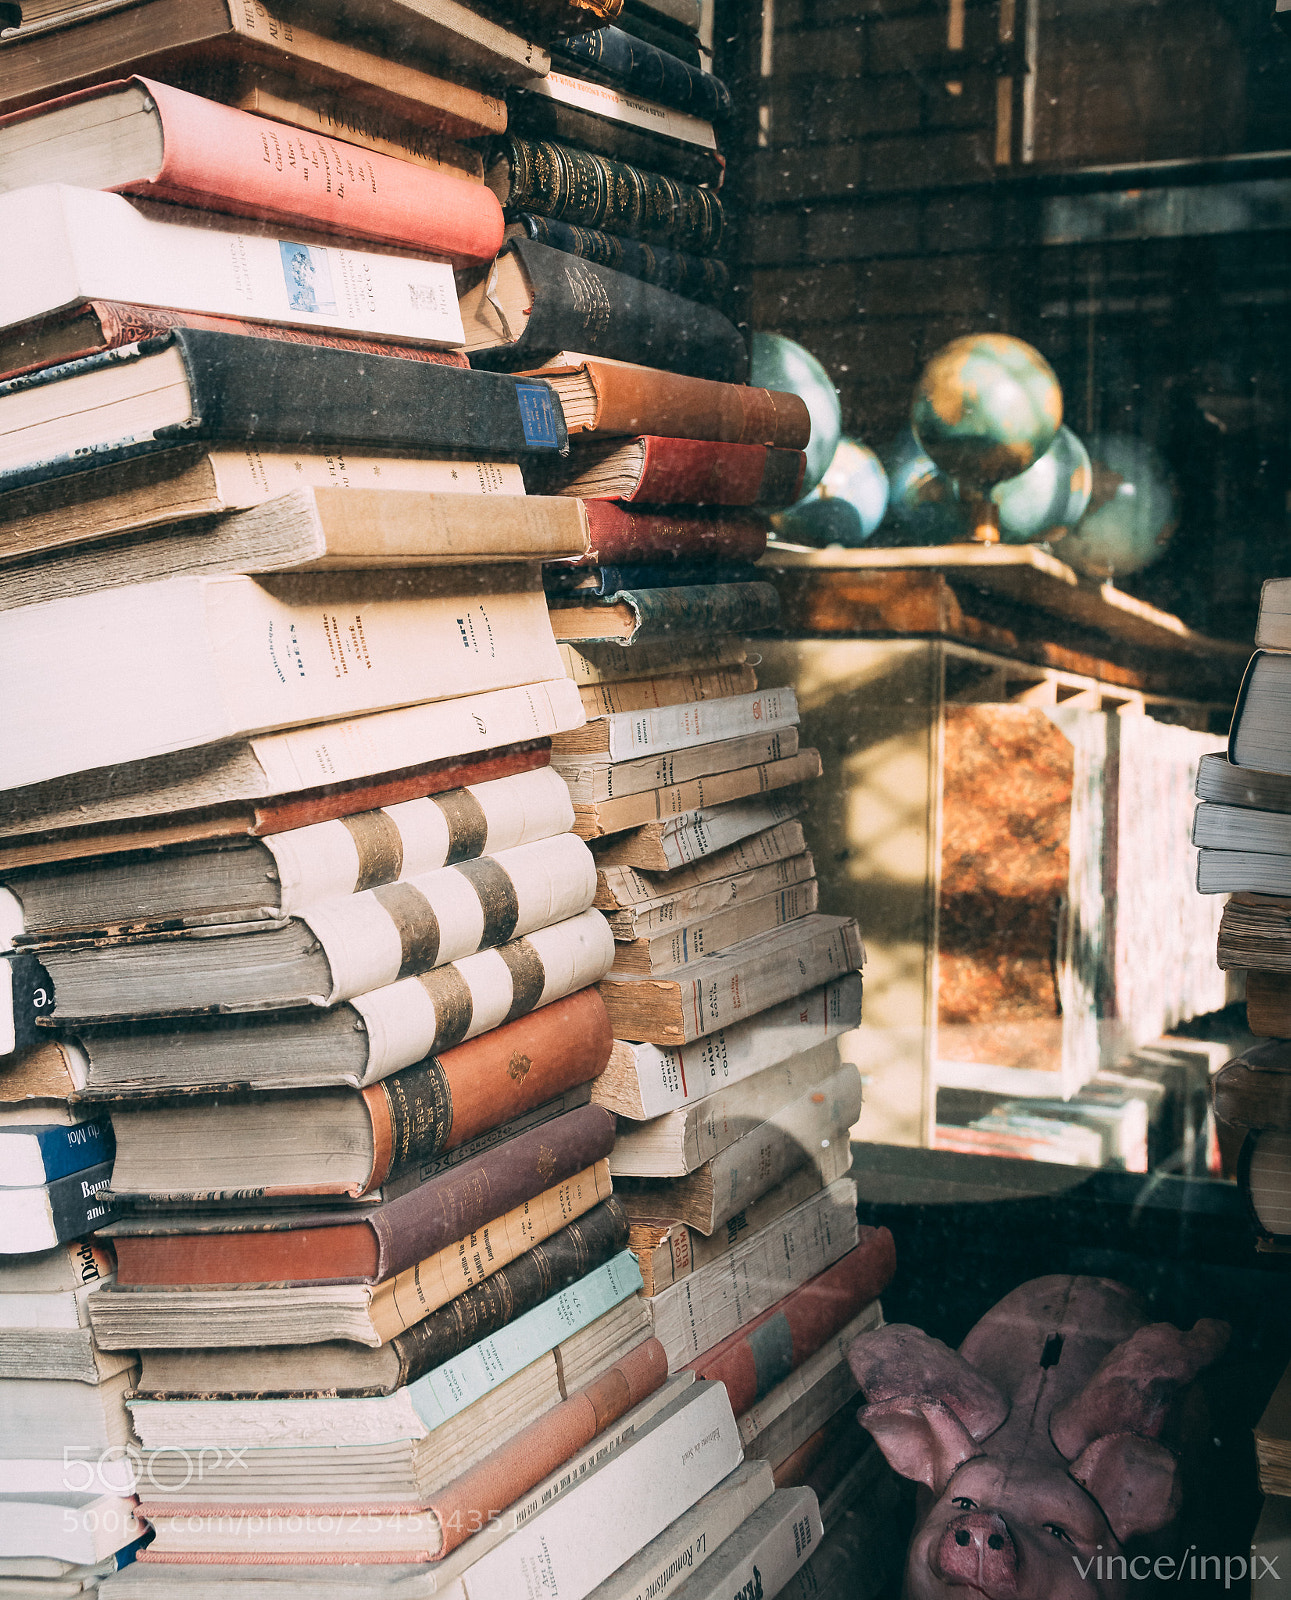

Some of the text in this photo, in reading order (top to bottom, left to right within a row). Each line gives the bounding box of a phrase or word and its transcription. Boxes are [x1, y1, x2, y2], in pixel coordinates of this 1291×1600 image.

[244, 6, 254, 28] THE
[268, 130, 285, 172] Carroll
[283, 139, 298, 169] Alice
[301, 166, 311, 182] au
[356, 165, 366, 181] du
[333, 180, 347, 199] De
[701, 1051, 706, 1062] LE
[714, 1045, 720, 1058] AU
[426, 1064, 443, 1121] TEMPS
[392, 1079, 413, 1161] DANIEL-ROPS
[67, 1130, 88, 1148] Moi
[563, 1184, 574, 1212] PARIS
[86, 1204, 105, 1221] and
[676, 1230, 691, 1267] BLUM
[476, 1342, 490, 1370] Renard
[449, 1365, 464, 1398] SILONE
[696, 1532, 707, 1553] Le
[644, 1544, 694, 1600] Romantisme
